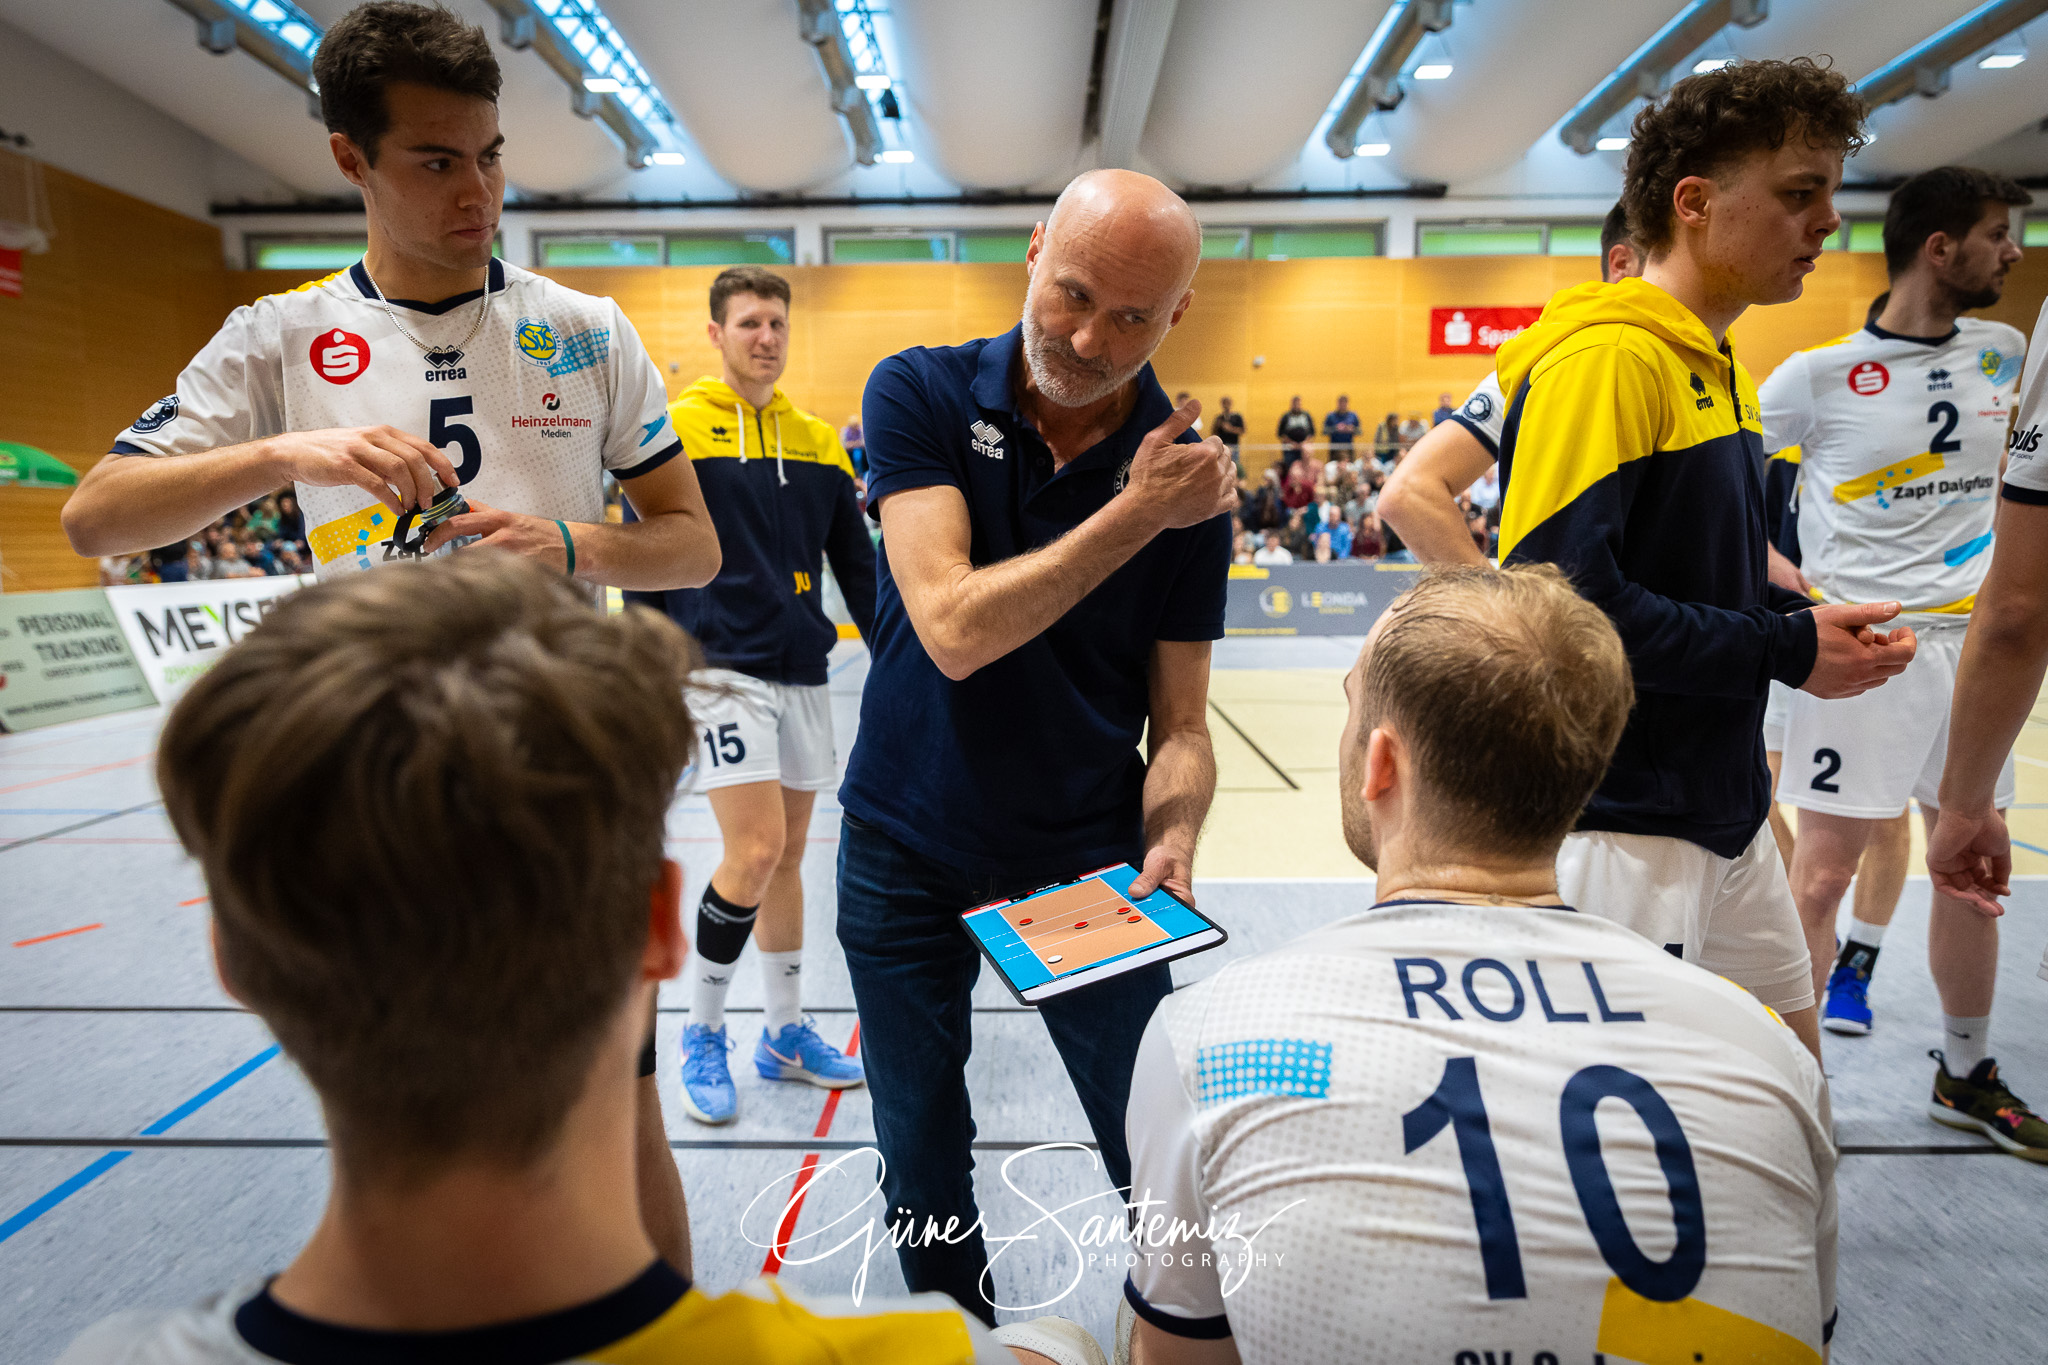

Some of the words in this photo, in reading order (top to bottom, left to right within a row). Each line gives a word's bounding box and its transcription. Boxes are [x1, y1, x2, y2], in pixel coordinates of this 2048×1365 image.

[425, 367, 467, 382] errea
[511, 415, 592, 428] Heinzelmann
[541, 429, 572, 438] Medien
[1927, 400, 1961, 454] 2
[429, 395, 482, 487] 5
[971, 438, 1004, 460] errea
[1893, 482, 1935, 499] Zapf
[1301, 591, 1369, 608] LEONDA
[703, 722, 746, 768] 15
[1810, 747, 1842, 793] 2
[1393, 957, 1646, 1023] ROLL
[1402, 1055, 1707, 1303] 10
